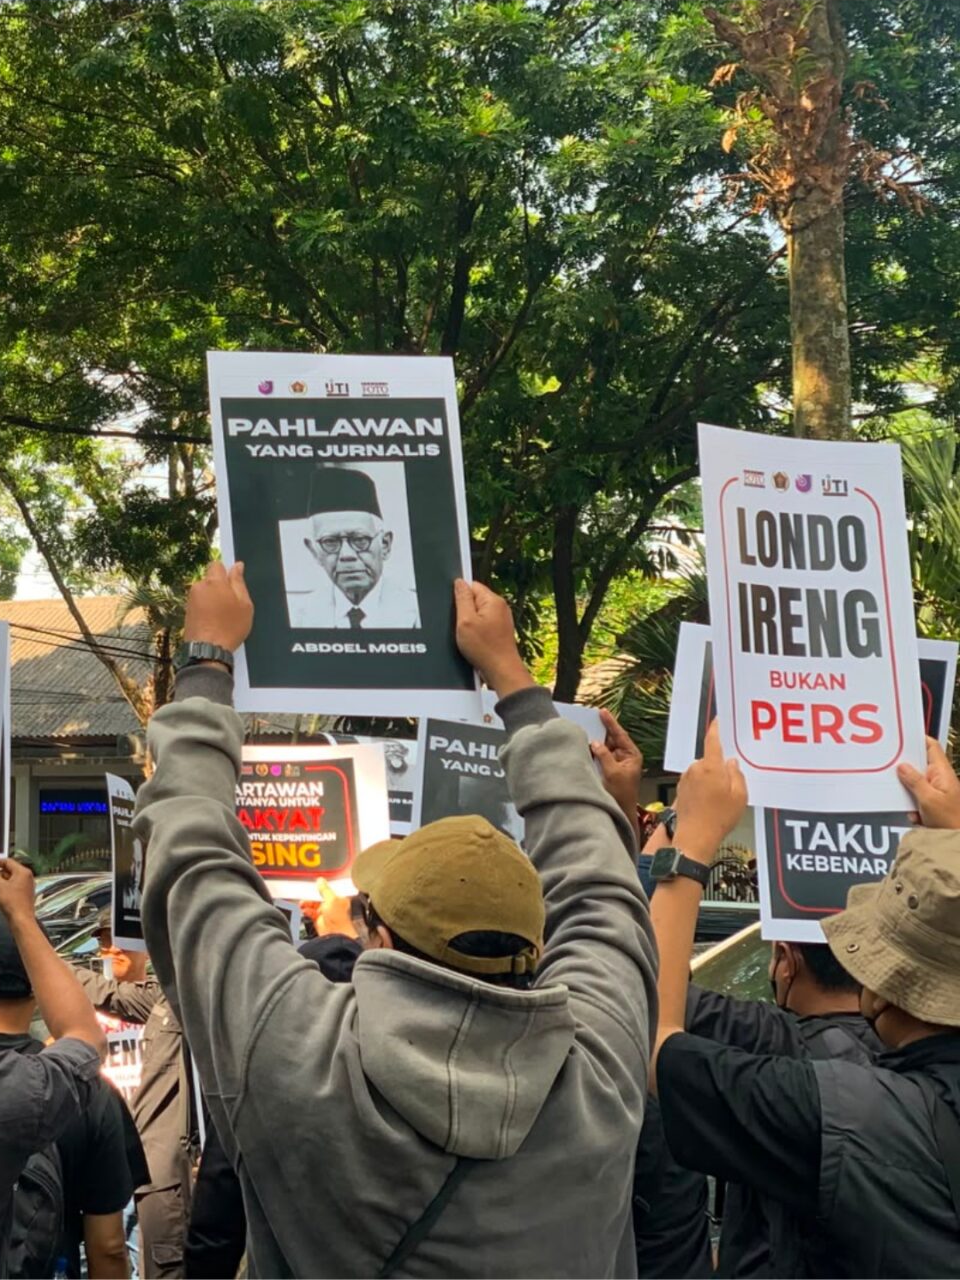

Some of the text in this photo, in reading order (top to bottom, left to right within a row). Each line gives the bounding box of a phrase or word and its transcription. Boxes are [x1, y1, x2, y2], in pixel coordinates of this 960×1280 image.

[227, 417, 444, 437] PAHLAWAN
[245, 443, 441, 458] YANG JURNALIS
[737, 507, 868, 573] LONDO
[738, 582, 883, 659] IRENG
[291, 643, 427, 654] ABDOEL MOEIS
[770, 670, 846, 690] BUKAN
[751, 700, 883, 745] PERS
[429, 735, 500, 761] PAHL
[440, 758, 491, 776] YANG
[235, 782, 324, 797] ARTAWAN
[279, 797, 320, 807] UNTUK
[238, 807, 325, 831] AKYAT
[251, 841, 321, 868] SING
[786, 853, 894, 875] KEBENAR
